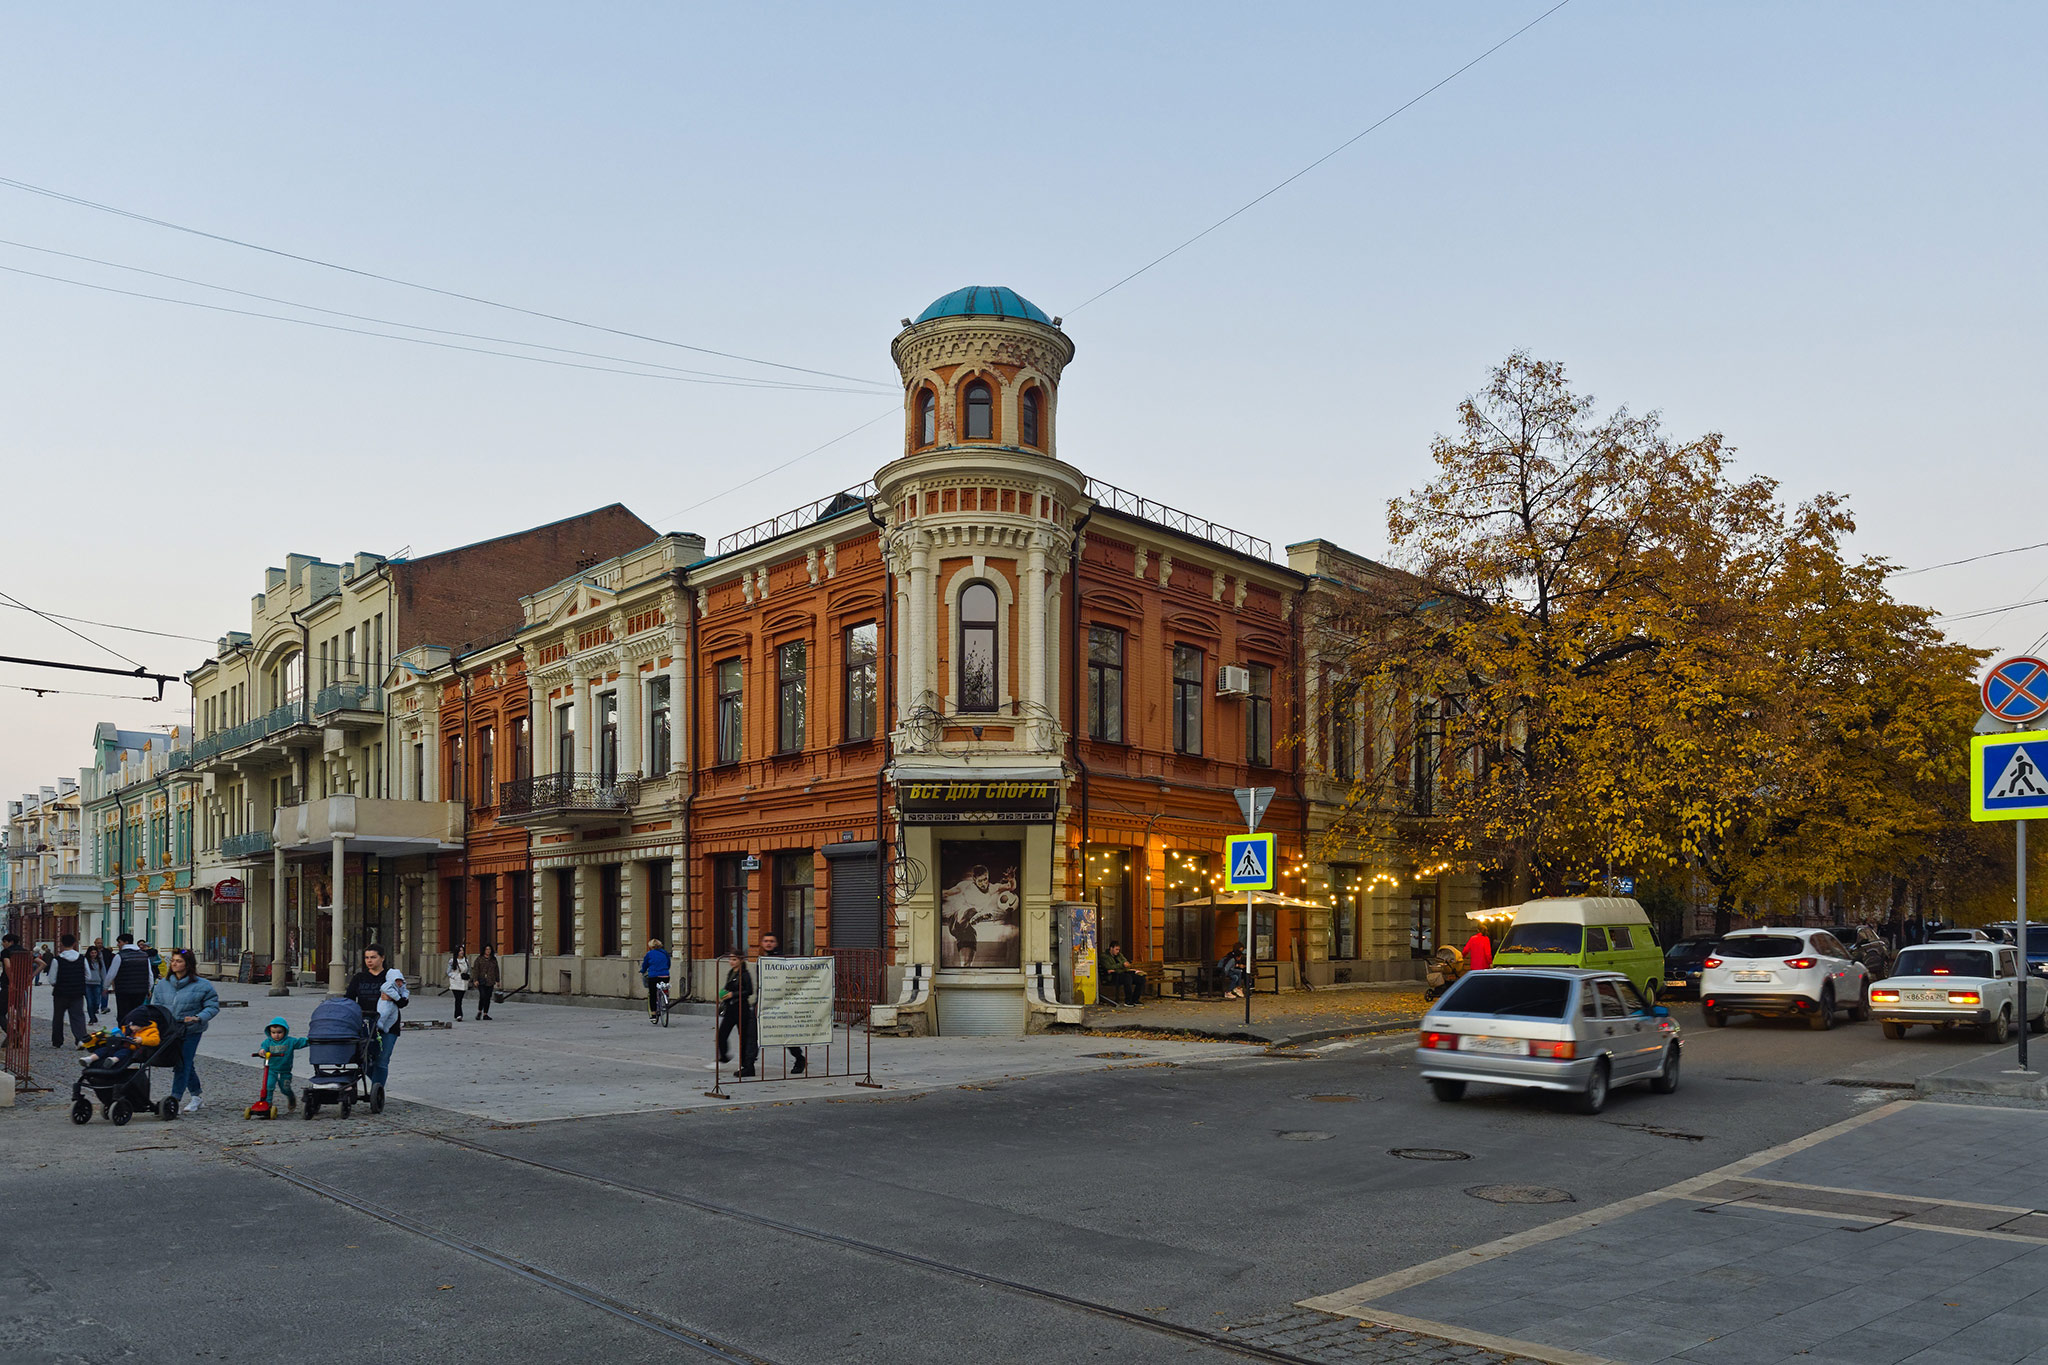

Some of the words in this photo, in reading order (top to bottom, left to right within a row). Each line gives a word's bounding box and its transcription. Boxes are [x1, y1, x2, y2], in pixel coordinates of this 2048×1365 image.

[910, 783, 943, 799] ВСЕ
[945, 782, 981, 801] ДЛЯ
[985, 782, 1048, 799] СПОРТА
[764, 963, 798, 971] ПАСПОРТ
